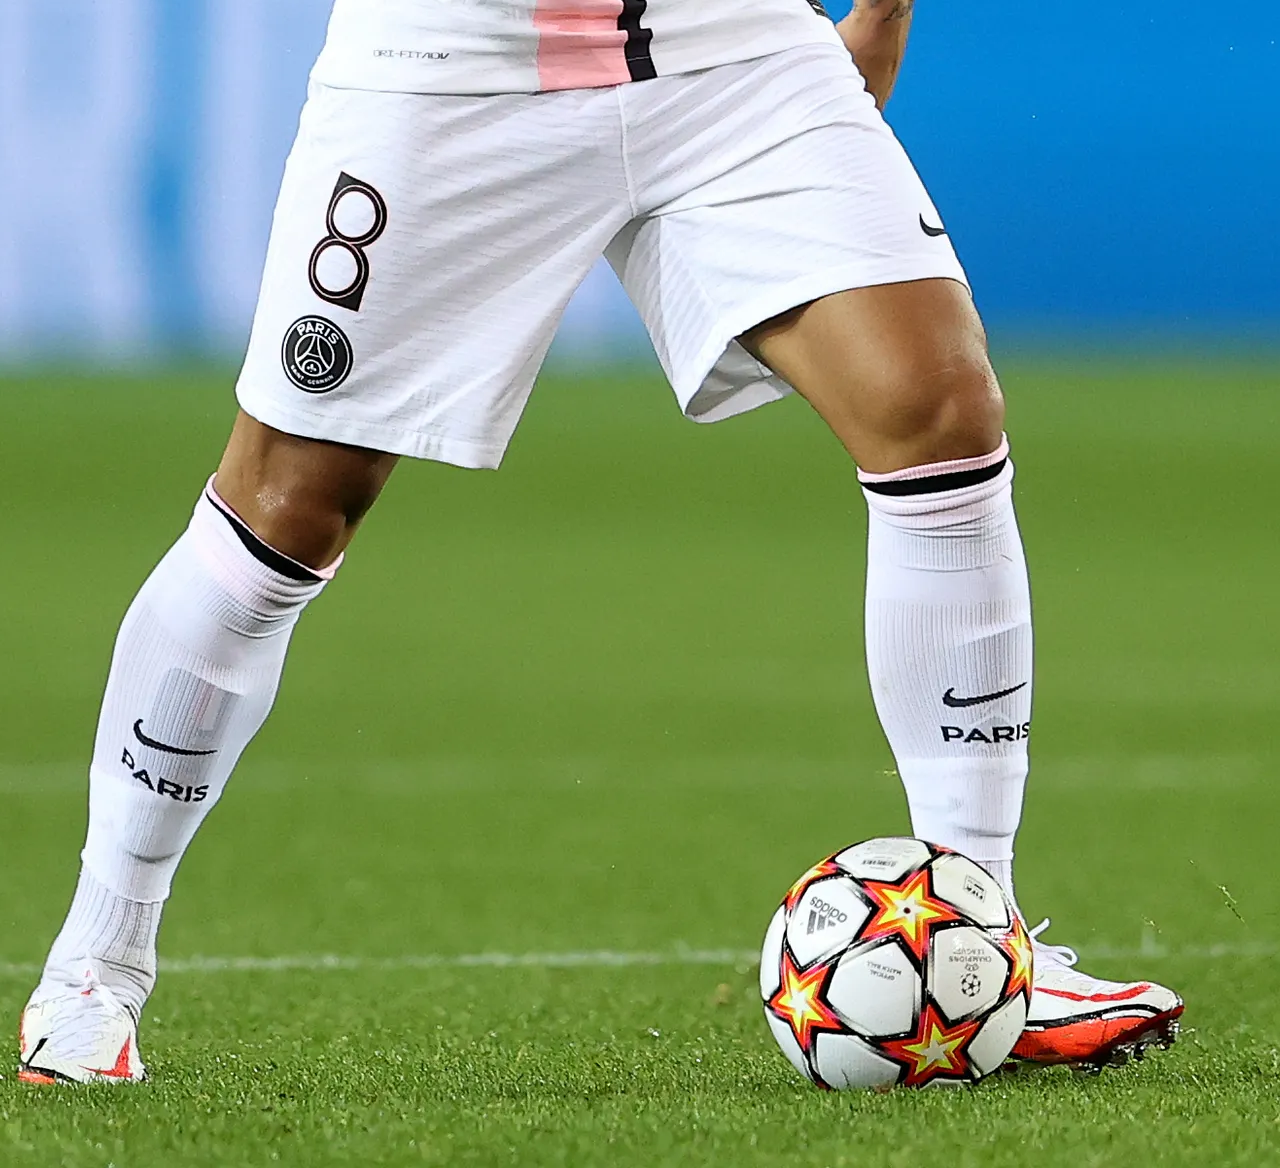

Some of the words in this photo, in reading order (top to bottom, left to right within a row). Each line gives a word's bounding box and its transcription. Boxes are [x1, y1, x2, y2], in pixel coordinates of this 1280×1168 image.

[308, 171, 388, 311] 8
[296, 321, 339, 345] PARIS
[940, 721, 1030, 744] PARIS
[121, 746, 210, 803] PARIS
[809, 896, 848, 923] adidas
